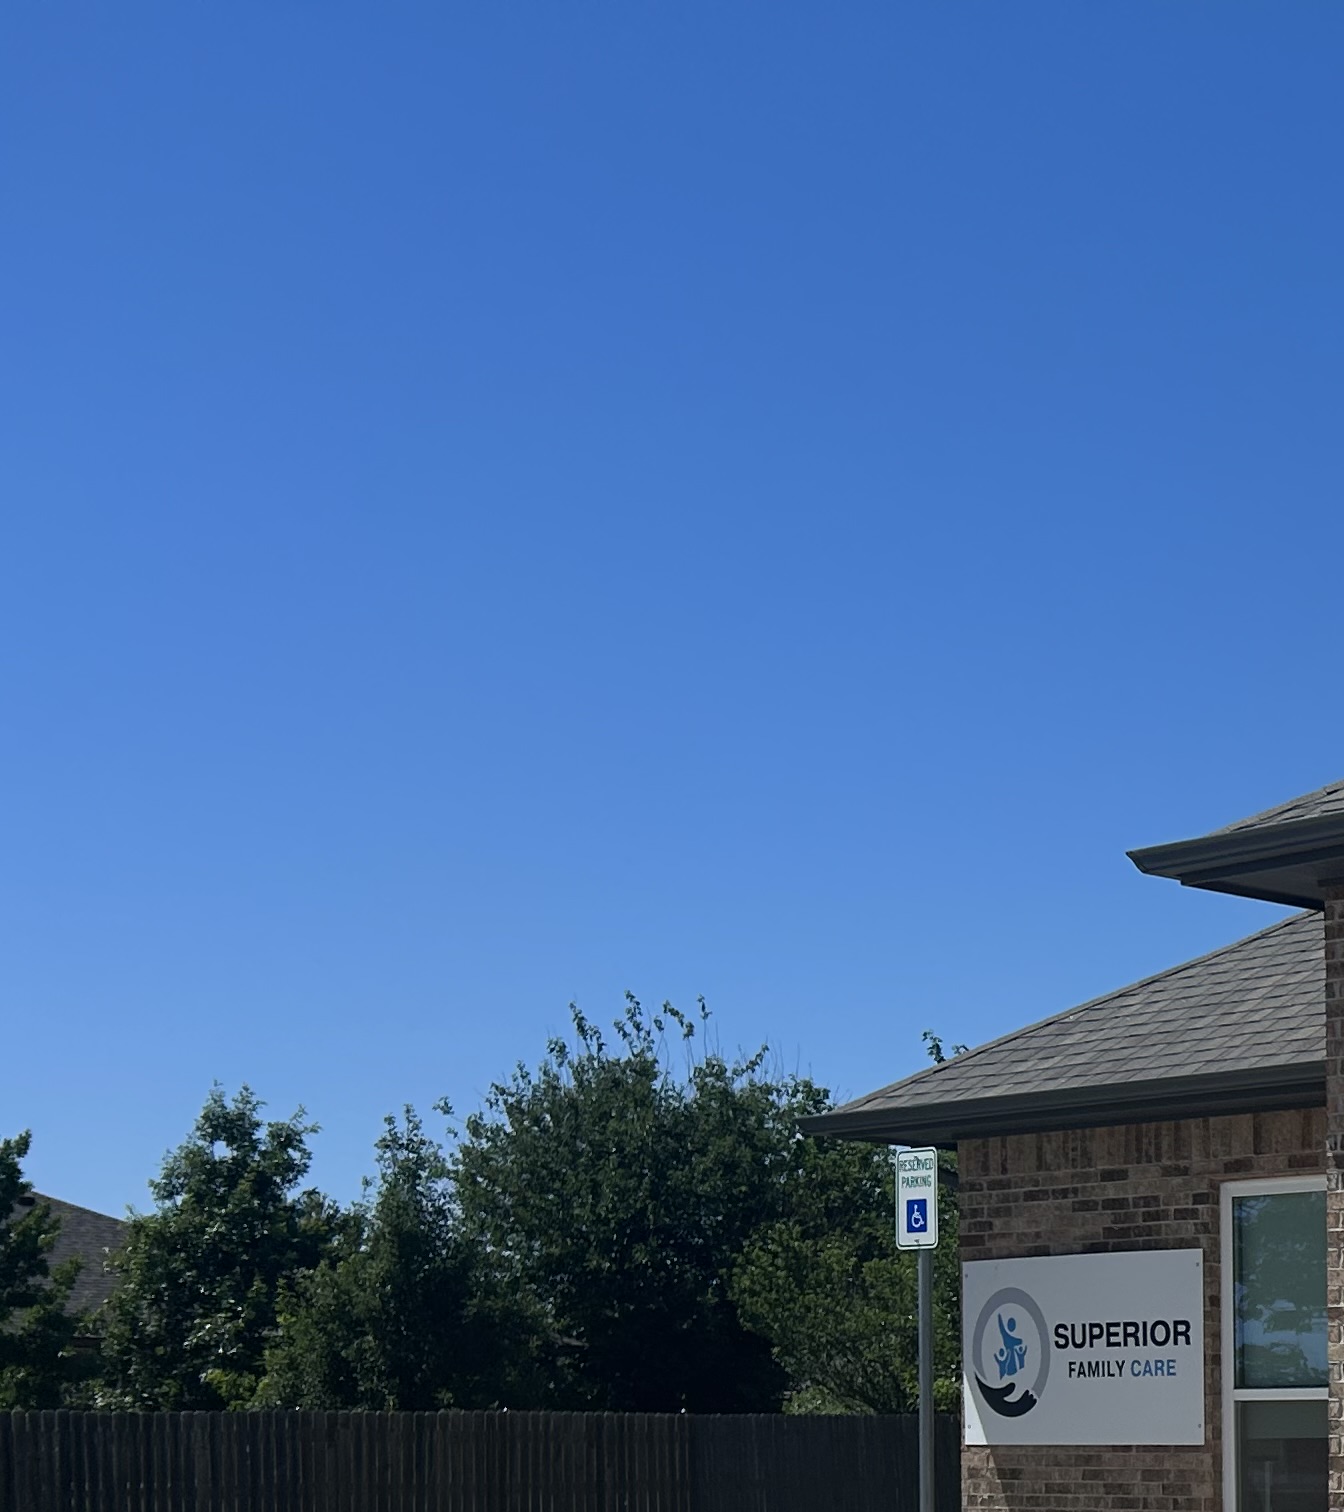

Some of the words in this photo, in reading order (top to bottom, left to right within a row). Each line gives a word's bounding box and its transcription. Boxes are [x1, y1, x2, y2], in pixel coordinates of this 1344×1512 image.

[898, 1157, 933, 1172] RESERVED
[901, 1174, 932, 1188] PARKING
[1053, 1319, 1192, 1349] SUPERIOR
[1068, 1360, 1126, 1378] FAMILY
[1130, 1359, 1177, 1377] CARE
